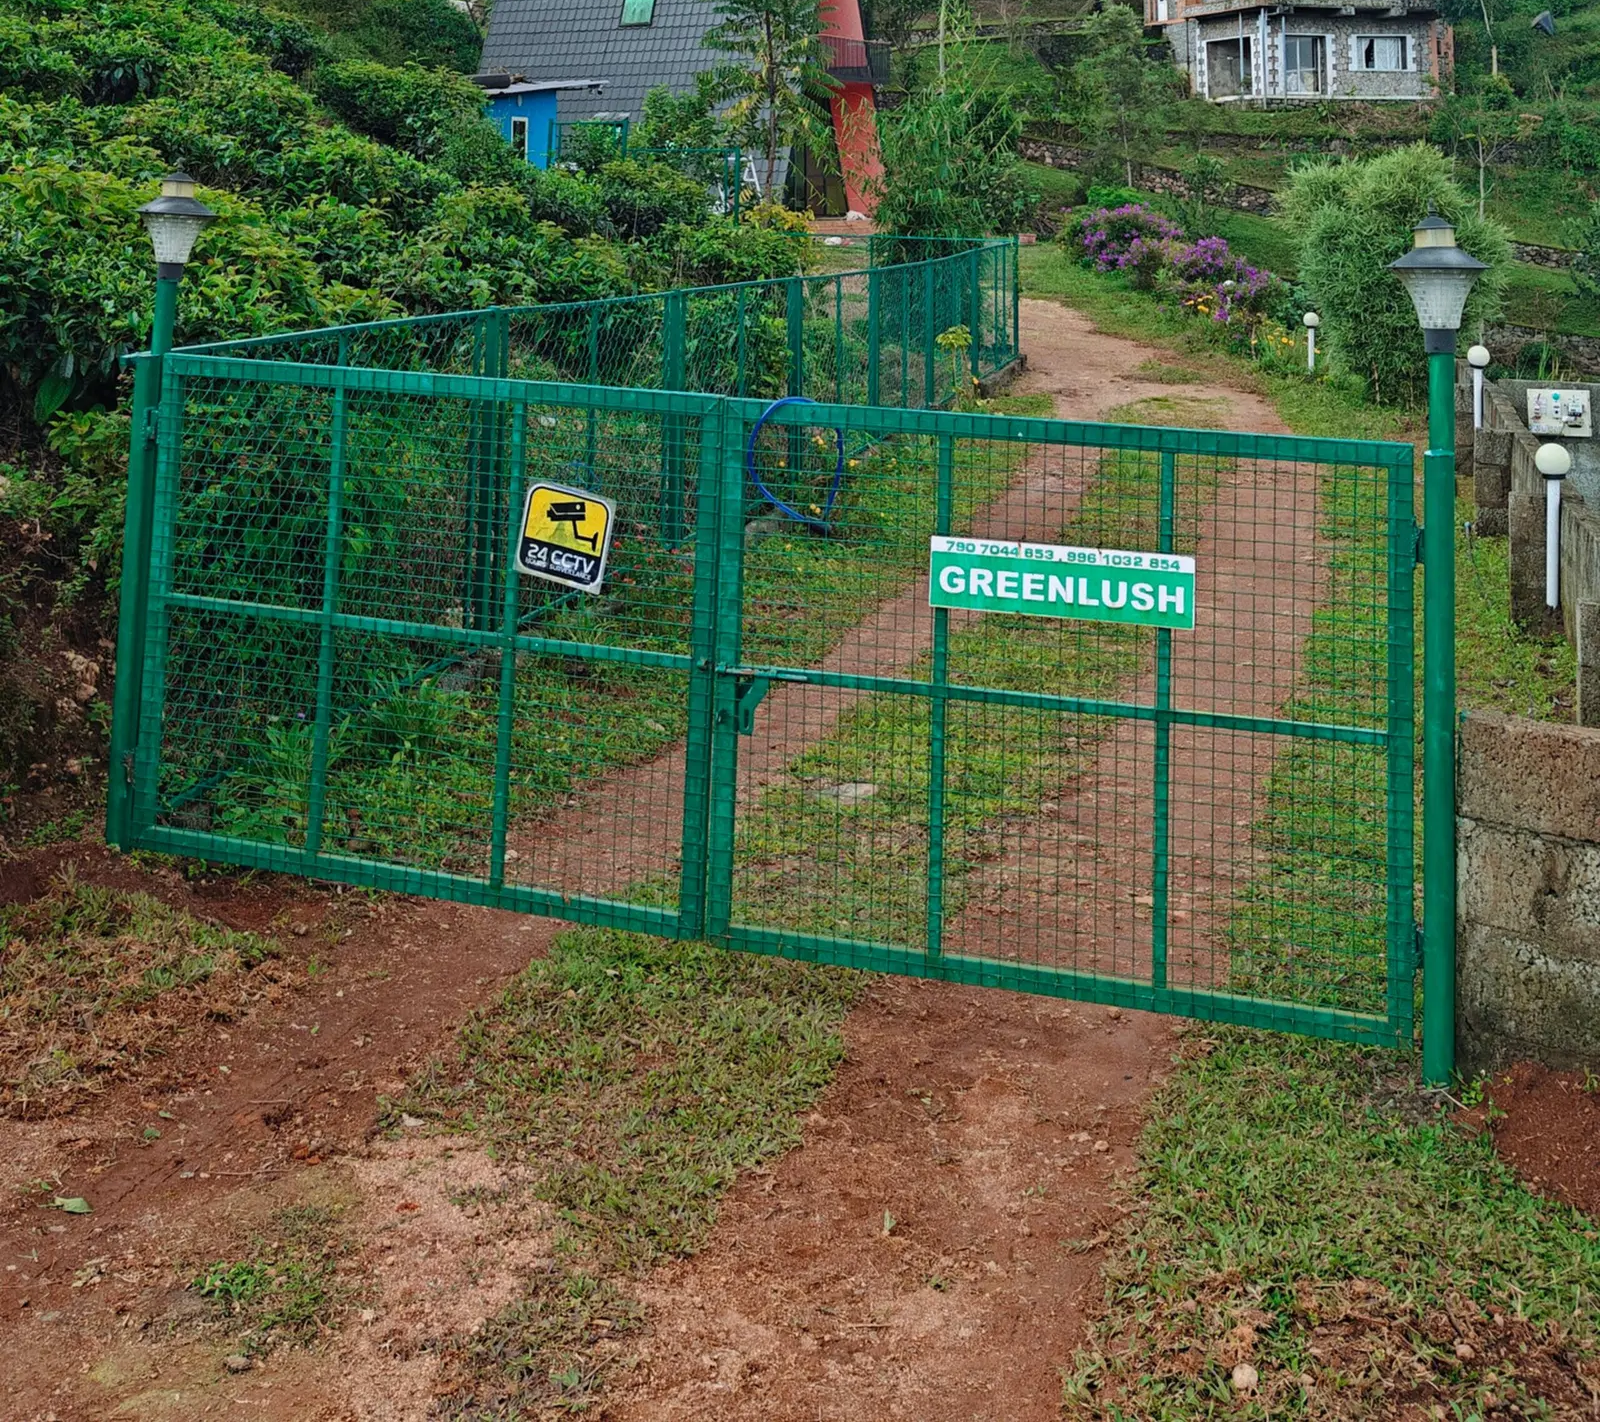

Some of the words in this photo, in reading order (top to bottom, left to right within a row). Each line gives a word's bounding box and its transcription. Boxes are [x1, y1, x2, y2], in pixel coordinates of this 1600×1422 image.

[528, 544, 548, 562] 24
[551, 550, 595, 573] CCTV
[947, 540, 976, 554] 790
[981, 544, 1019, 558] 7044
[1067, 551, 1097, 563] 996
[1103, 554, 1143, 567] 1032
[1150, 558, 1180, 571] 854
[939, 565, 1185, 614] GREENLUSH
